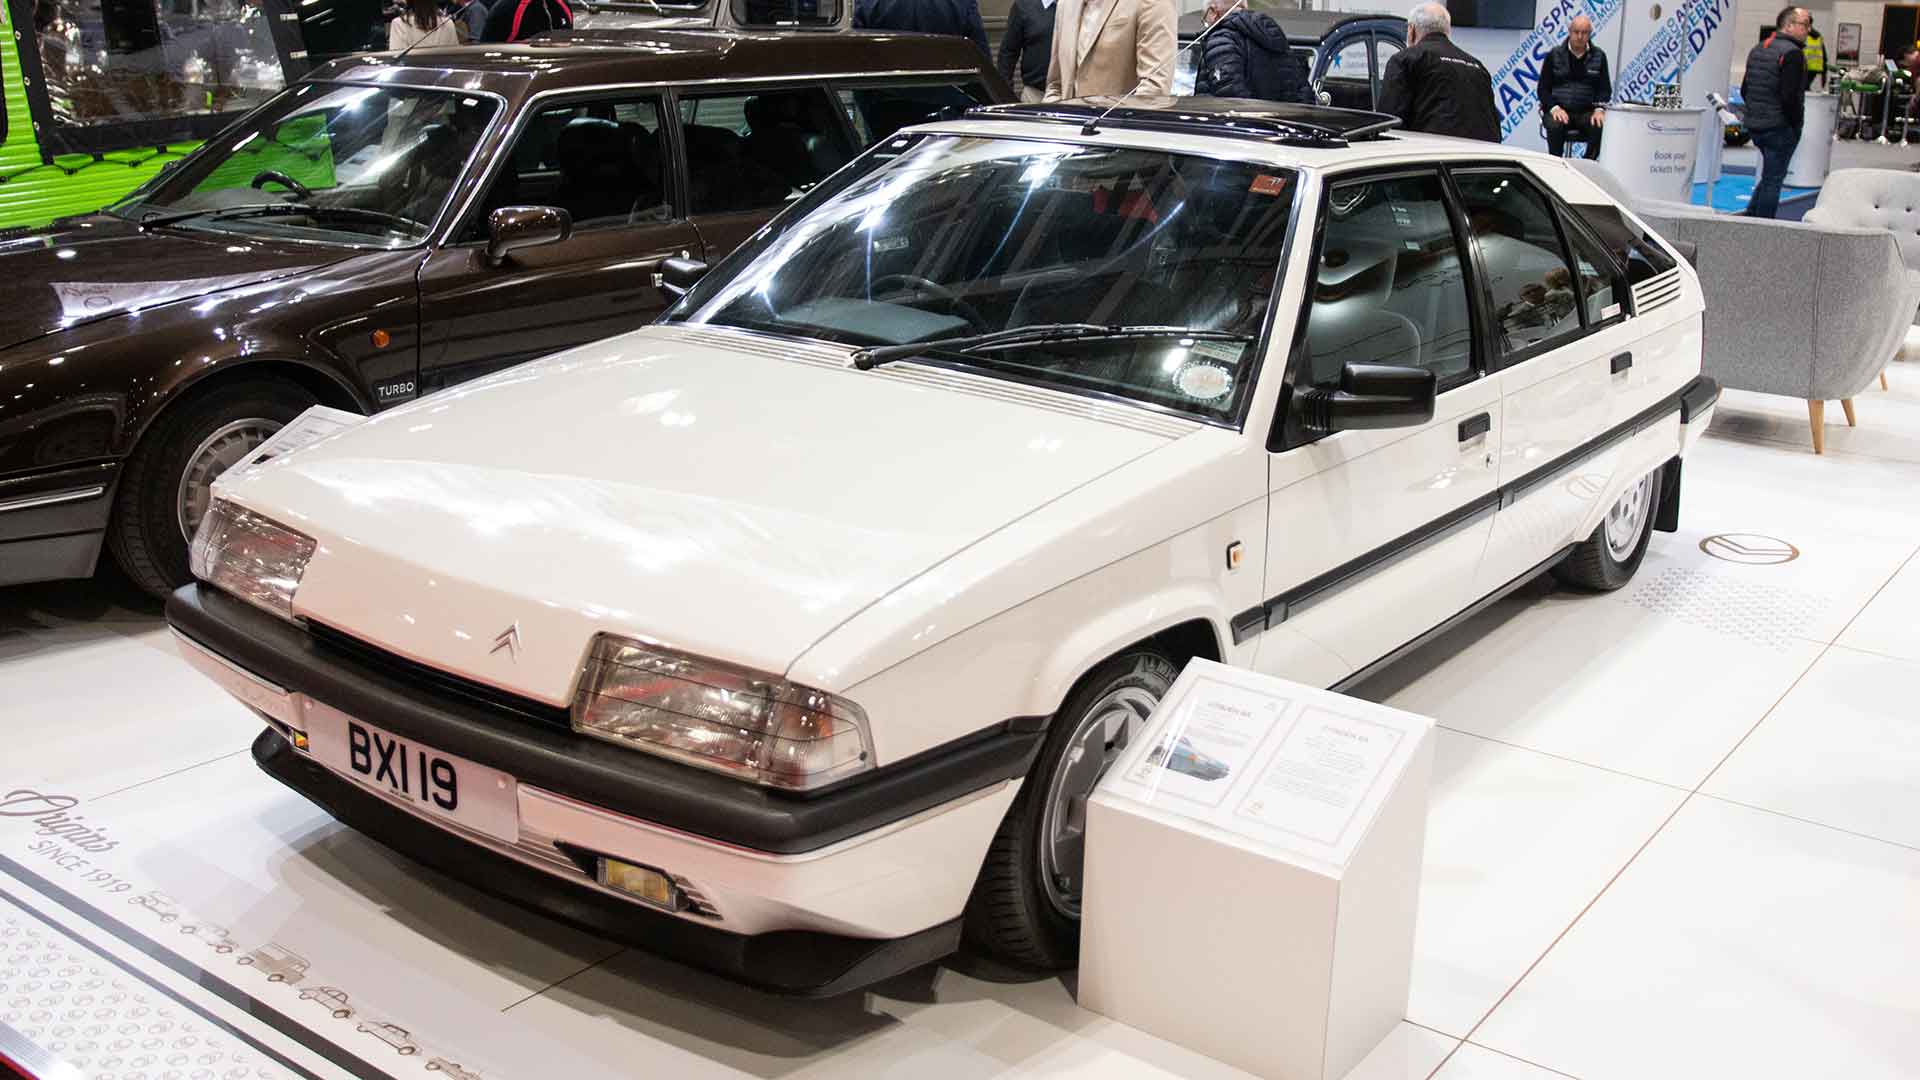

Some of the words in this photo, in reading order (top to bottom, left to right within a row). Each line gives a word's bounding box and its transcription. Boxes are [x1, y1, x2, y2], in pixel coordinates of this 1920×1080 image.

[1542, 0, 1574, 34] SPA
[1687, 0, 1729, 55] DAY
[1497, 41, 1549, 121] ANS
[378, 381, 415, 397] TURBO
[419, 751, 459, 811] 19
[0, 790, 120, 853] Origins
[27, 840, 91, 871] SINCE
[79, 868, 132, 893] 1919
